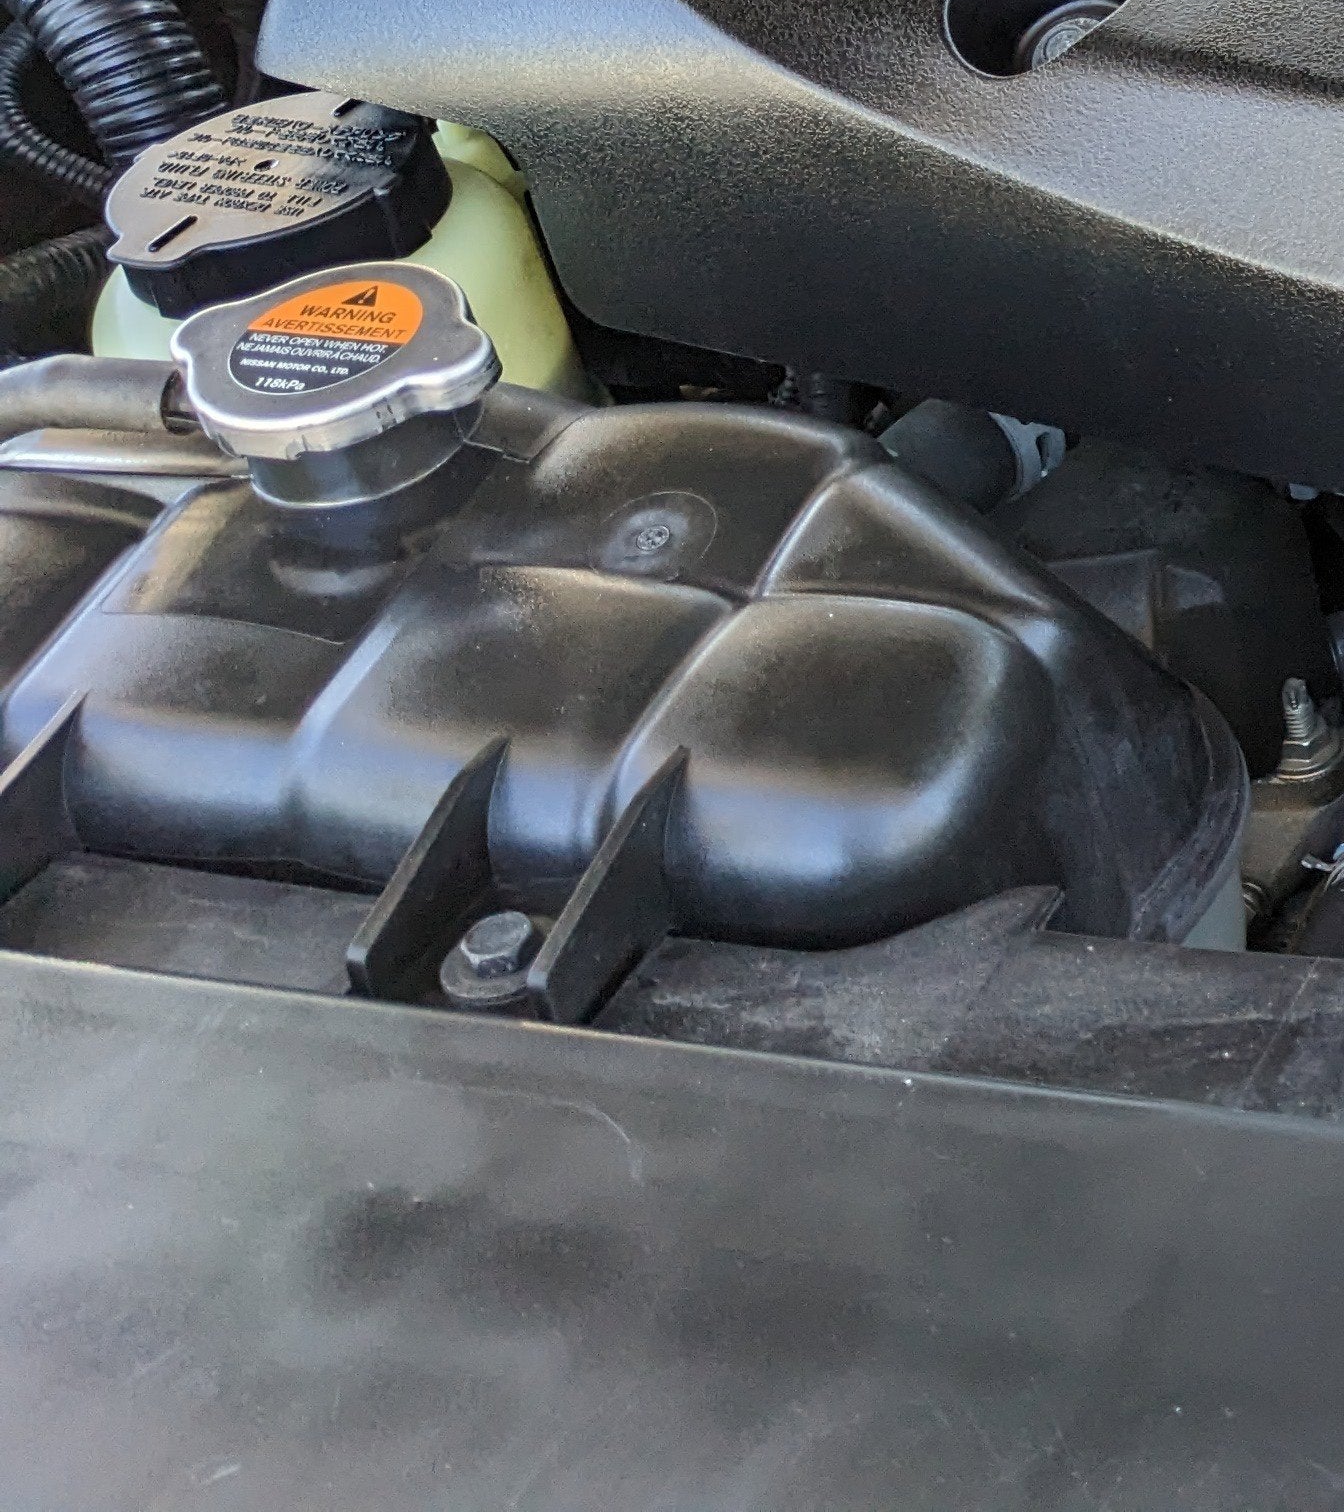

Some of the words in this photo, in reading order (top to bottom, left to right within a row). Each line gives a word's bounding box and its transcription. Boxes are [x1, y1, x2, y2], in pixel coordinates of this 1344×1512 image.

[157, 163, 211, 176] FLUID
[212, 170, 293, 187] STEERING
[295, 179, 348, 195] POWER
[257, 190, 278, 201] TO
[286, 195, 324, 207] FILL
[300, 304, 397, 323] WARNING
[263, 318, 407, 338] AVERTISSEMENT
[249, 333, 291, 343] NEVER
[292, 336, 323, 347] OPEN
[323, 339, 361, 351] WHEN
[361, 343, 388, 353] HOT.
[237, 342, 254, 351] NE
[253, 344, 292, 355] JAMAIS
[291, 348, 333, 359] OUVRIR
[341, 352, 380, 363] CHAUD.
[240, 359, 276, 368] NISSAN
[276, 361, 311, 371] MOTOR
[330, 366, 349, 375] LTD.
[255, 377, 306, 391] 118kPa
